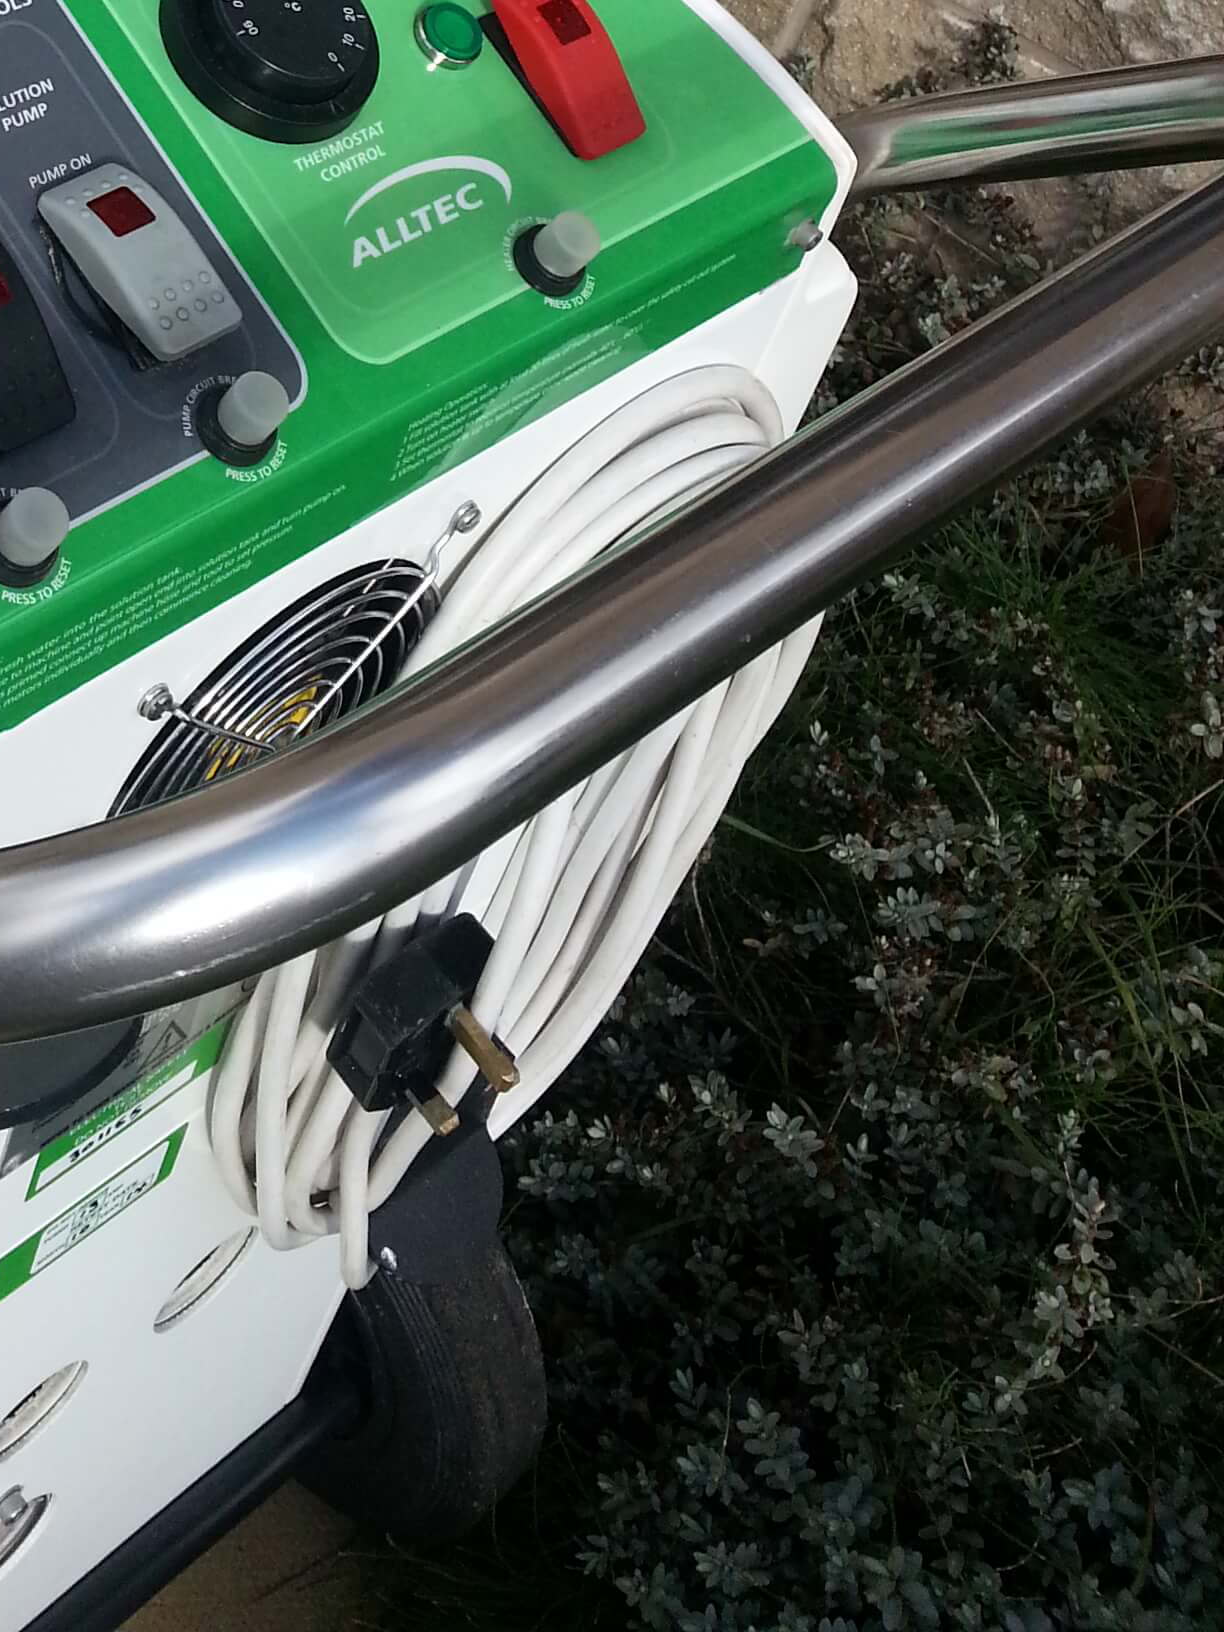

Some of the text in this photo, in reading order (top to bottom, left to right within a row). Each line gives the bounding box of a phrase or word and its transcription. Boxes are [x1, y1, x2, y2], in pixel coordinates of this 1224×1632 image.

[342, 7, 357, 23] 20
[327, 52, 339, 63] 0
[341, 33, 356, 47] 10
[1, 102, 48, 132] PUMP
[293, 120, 386, 173] THERMOSTAT
[320, 144, 387, 183] CONTROL
[28, 153, 93, 189] PUMP ON
[352, 182, 484, 269] ALLTEC
[571, 296, 584, 308] TO
[182, 375, 217, 437] PUMP CIRCUIT
[225, 439, 288, 482] PRESS TO RESET
[1, 556, 73, 605] PRESS TO RESET
[89, 608, 108, 624] the
